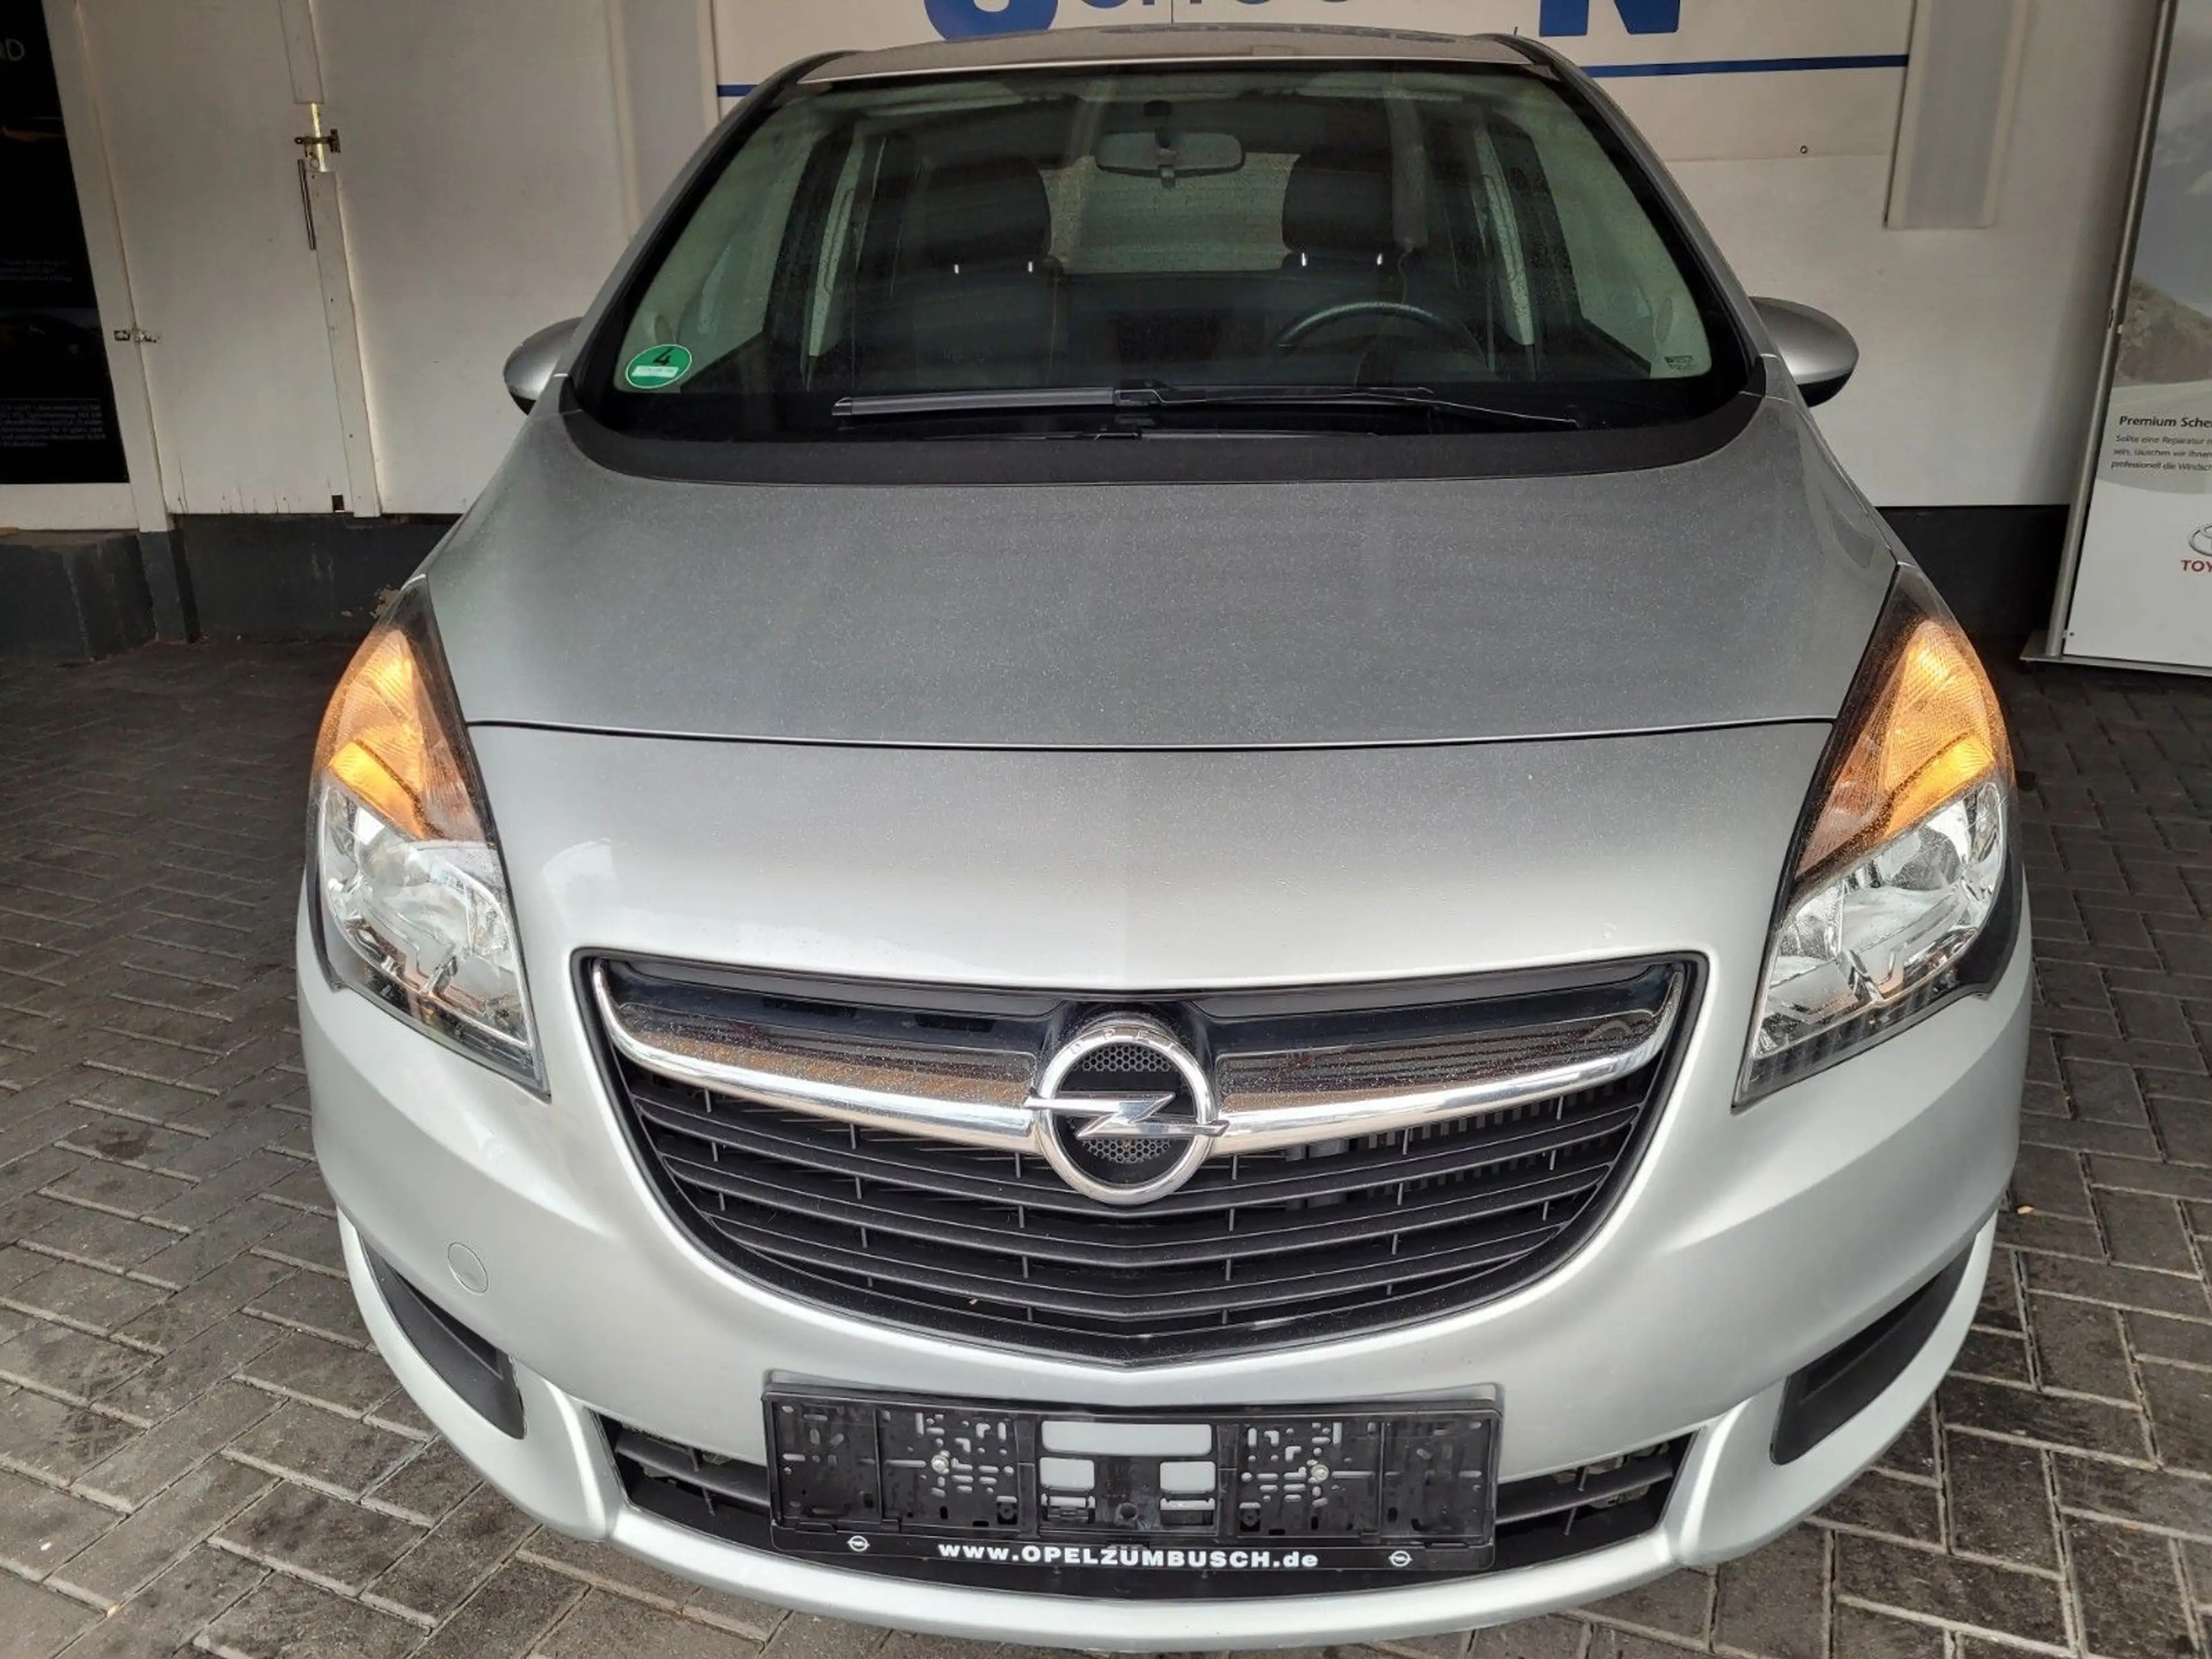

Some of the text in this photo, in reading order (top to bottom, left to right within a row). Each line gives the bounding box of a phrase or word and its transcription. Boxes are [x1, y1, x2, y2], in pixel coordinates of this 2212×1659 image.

[653, 346, 674, 365] 4
[2119, 415, 2177, 427] Premium
[938, 1543, 1319, 1568] www.OPELZUMBUSCH.de
